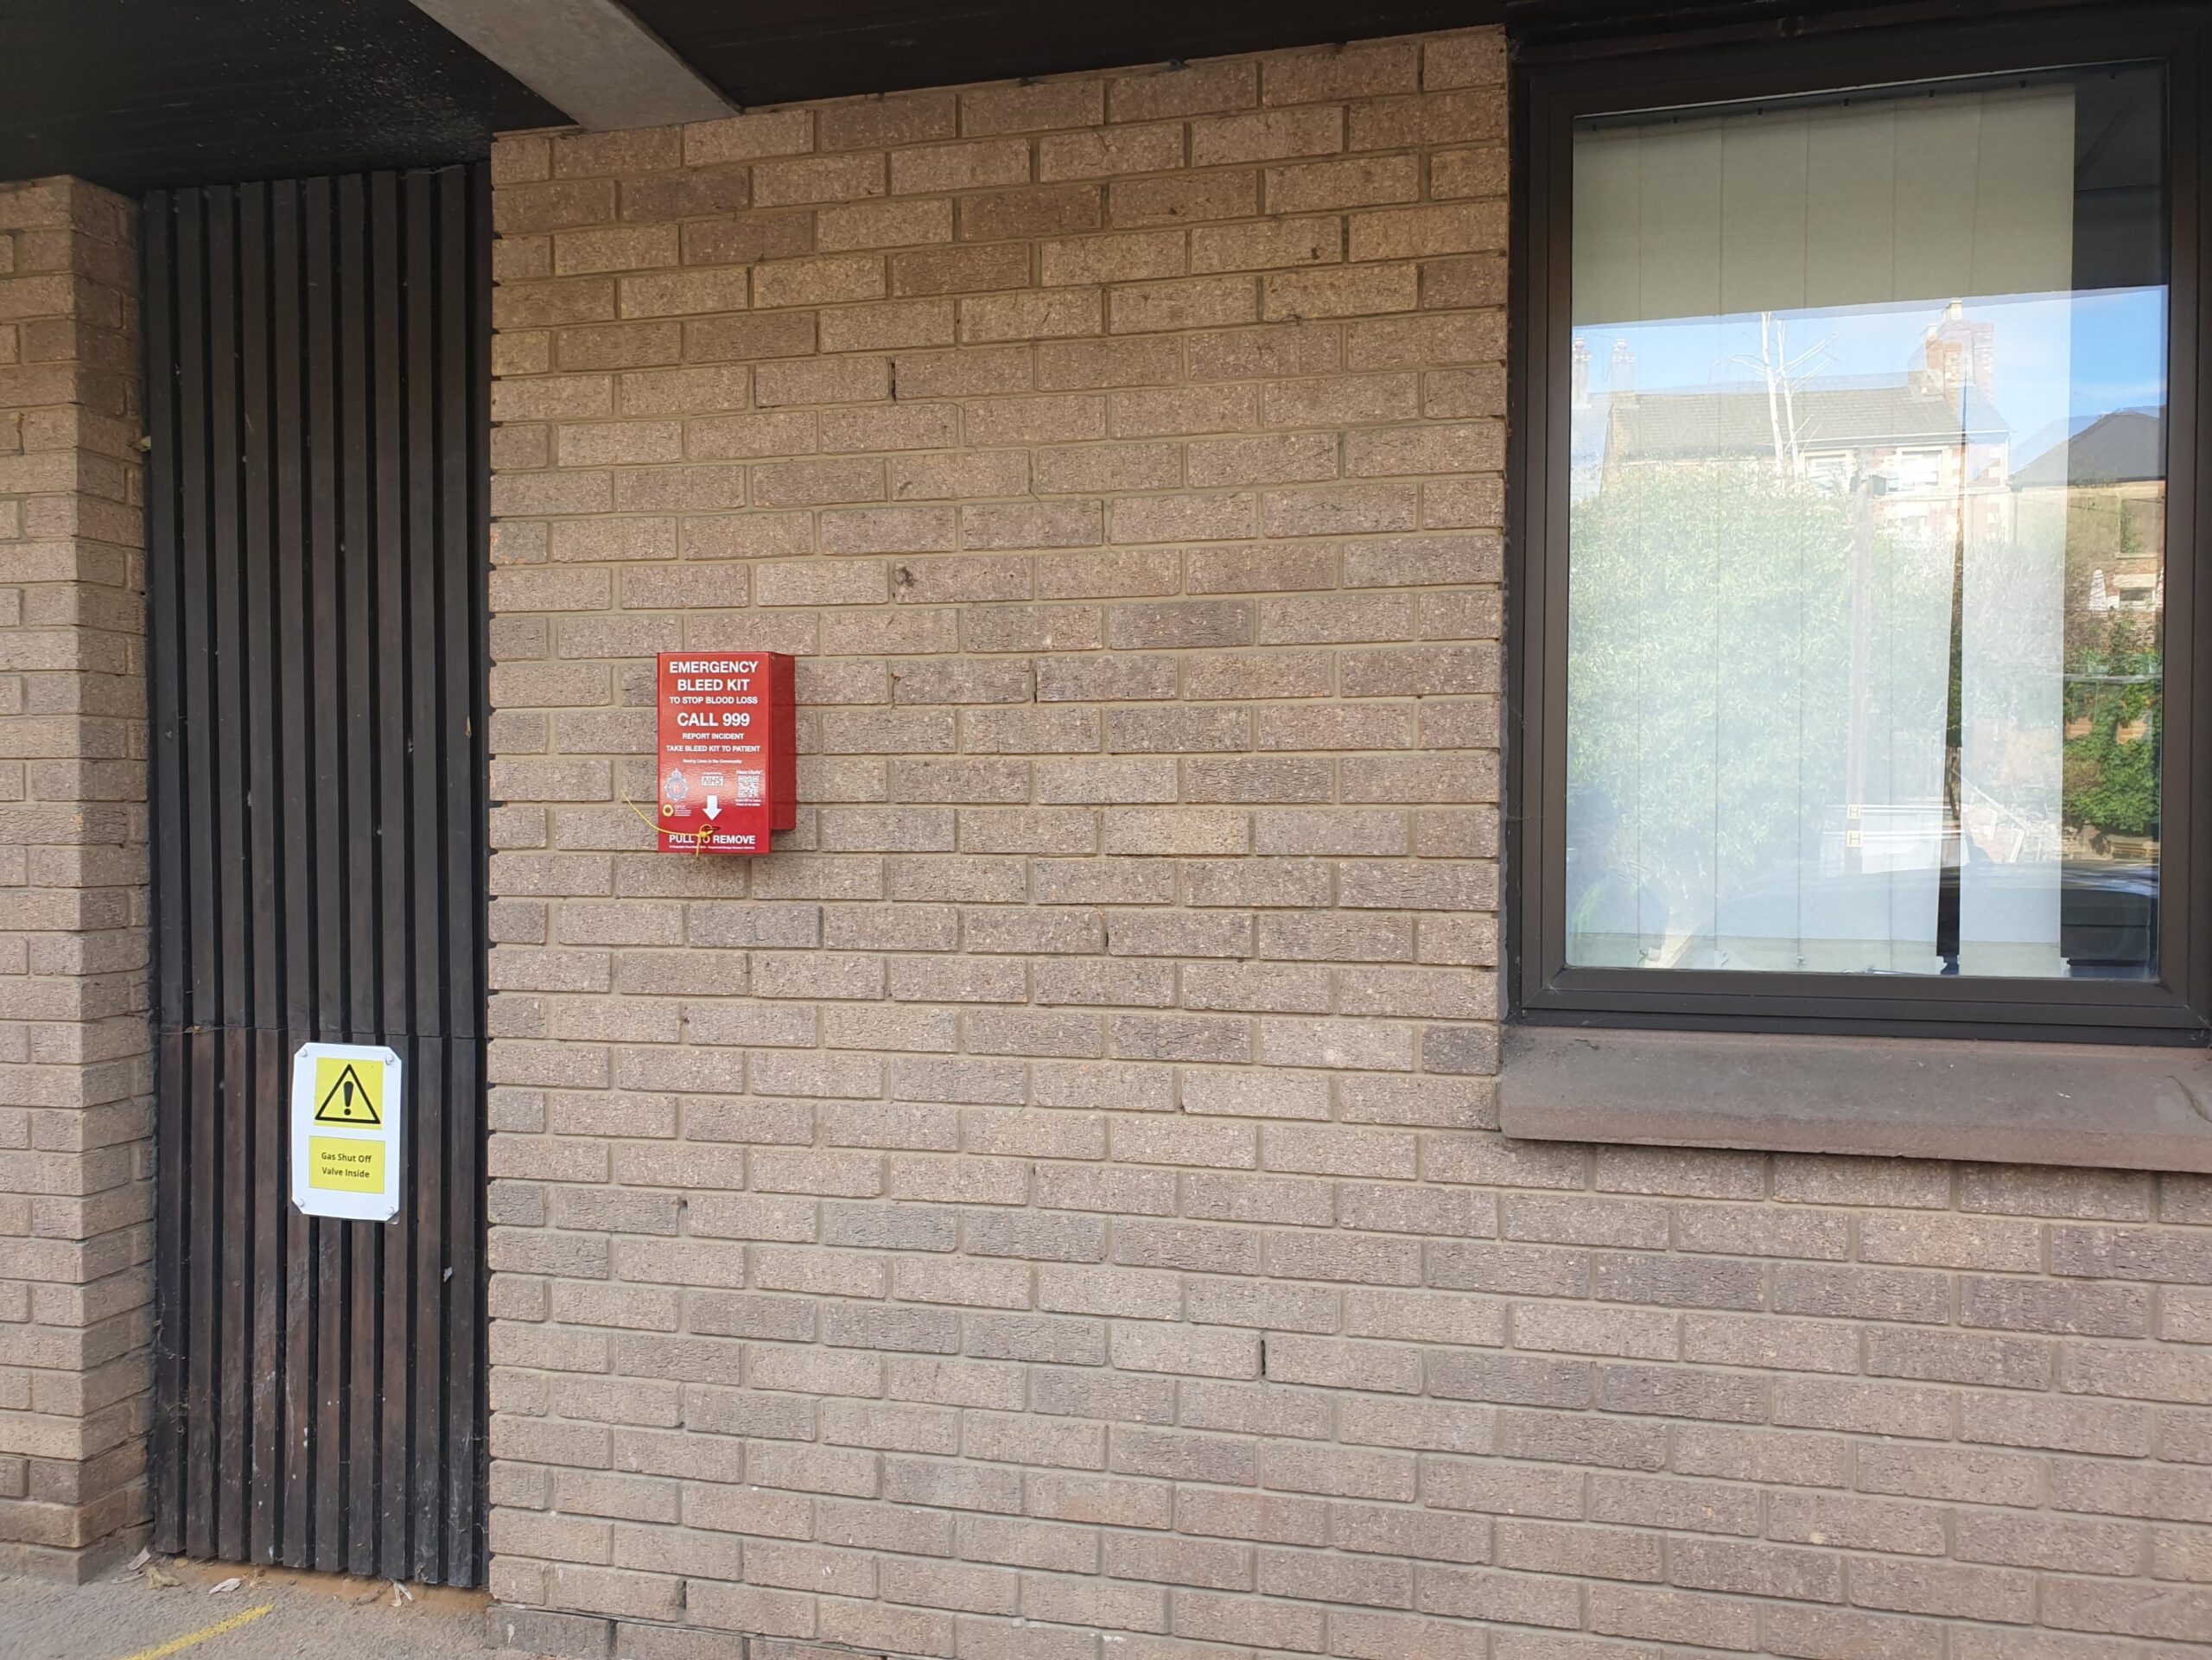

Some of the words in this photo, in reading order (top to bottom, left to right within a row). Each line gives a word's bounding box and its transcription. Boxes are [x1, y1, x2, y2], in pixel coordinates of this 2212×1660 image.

[670, 661, 759, 673] EMERGENCY
[677, 679, 723, 691] BLEED
[727, 679, 750, 691] KIT
[677, 712, 719, 727] CALL
[722, 712, 750, 727] 999
[702, 777, 722, 785] NHS
[670, 834, 695, 843] PULL
[713, 835, 756, 844] REMOVE
[321, 1152, 336, 1161] Gas
[338, 1153, 356, 1162] Shut
[359, 1154, 372, 1163] Off
[321, 1167, 343, 1176] Valve
[346, 1168, 370, 1178] Inside
